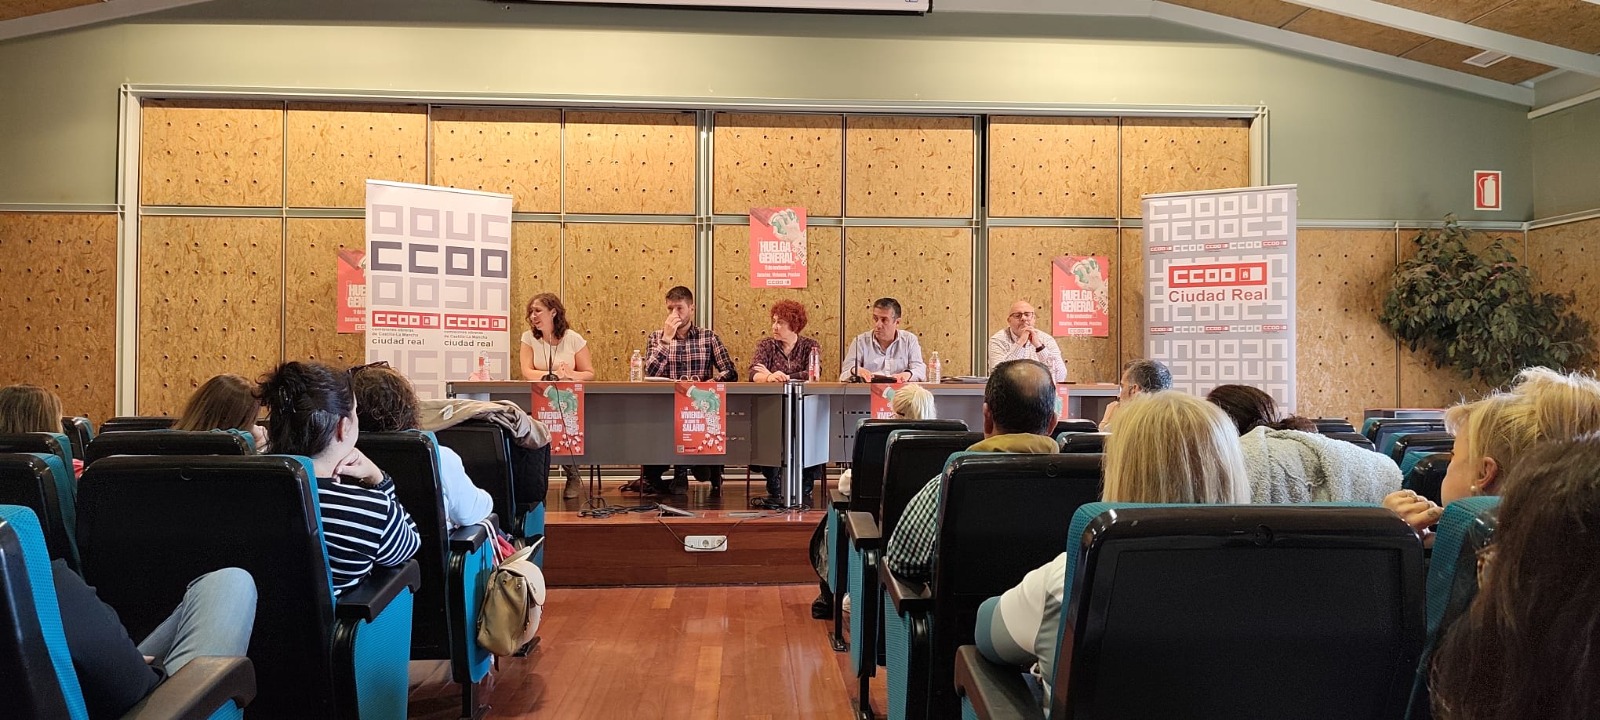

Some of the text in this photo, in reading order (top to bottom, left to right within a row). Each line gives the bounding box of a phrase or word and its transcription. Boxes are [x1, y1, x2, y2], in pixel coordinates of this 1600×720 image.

[759, 241, 791, 252] HUELGA
[1173, 244, 1204, 252] CCOO
[1229, 241, 1262, 250] CCOO
[371, 240, 508, 279] CCOO
[759, 252, 794, 264] GENERAL
[1173, 268, 1236, 284] CCOO
[1062, 289, 1093, 300] HUELGA
[1168, 288, 1268, 303] Ciudad Real
[1061, 300, 1096, 312] GENERAL
[374, 313, 421, 326] CCOO
[446, 316, 490, 328] CCOO
[1173, 326, 1205, 334] CCOO
[1229, 325, 1262, 333] CCOO
[371, 336, 425, 346] ciudad real
[444, 339, 475, 347] ciudad
[681, 411, 705, 419] VIVIENDA
[682, 423, 705, 432] SALARIO
